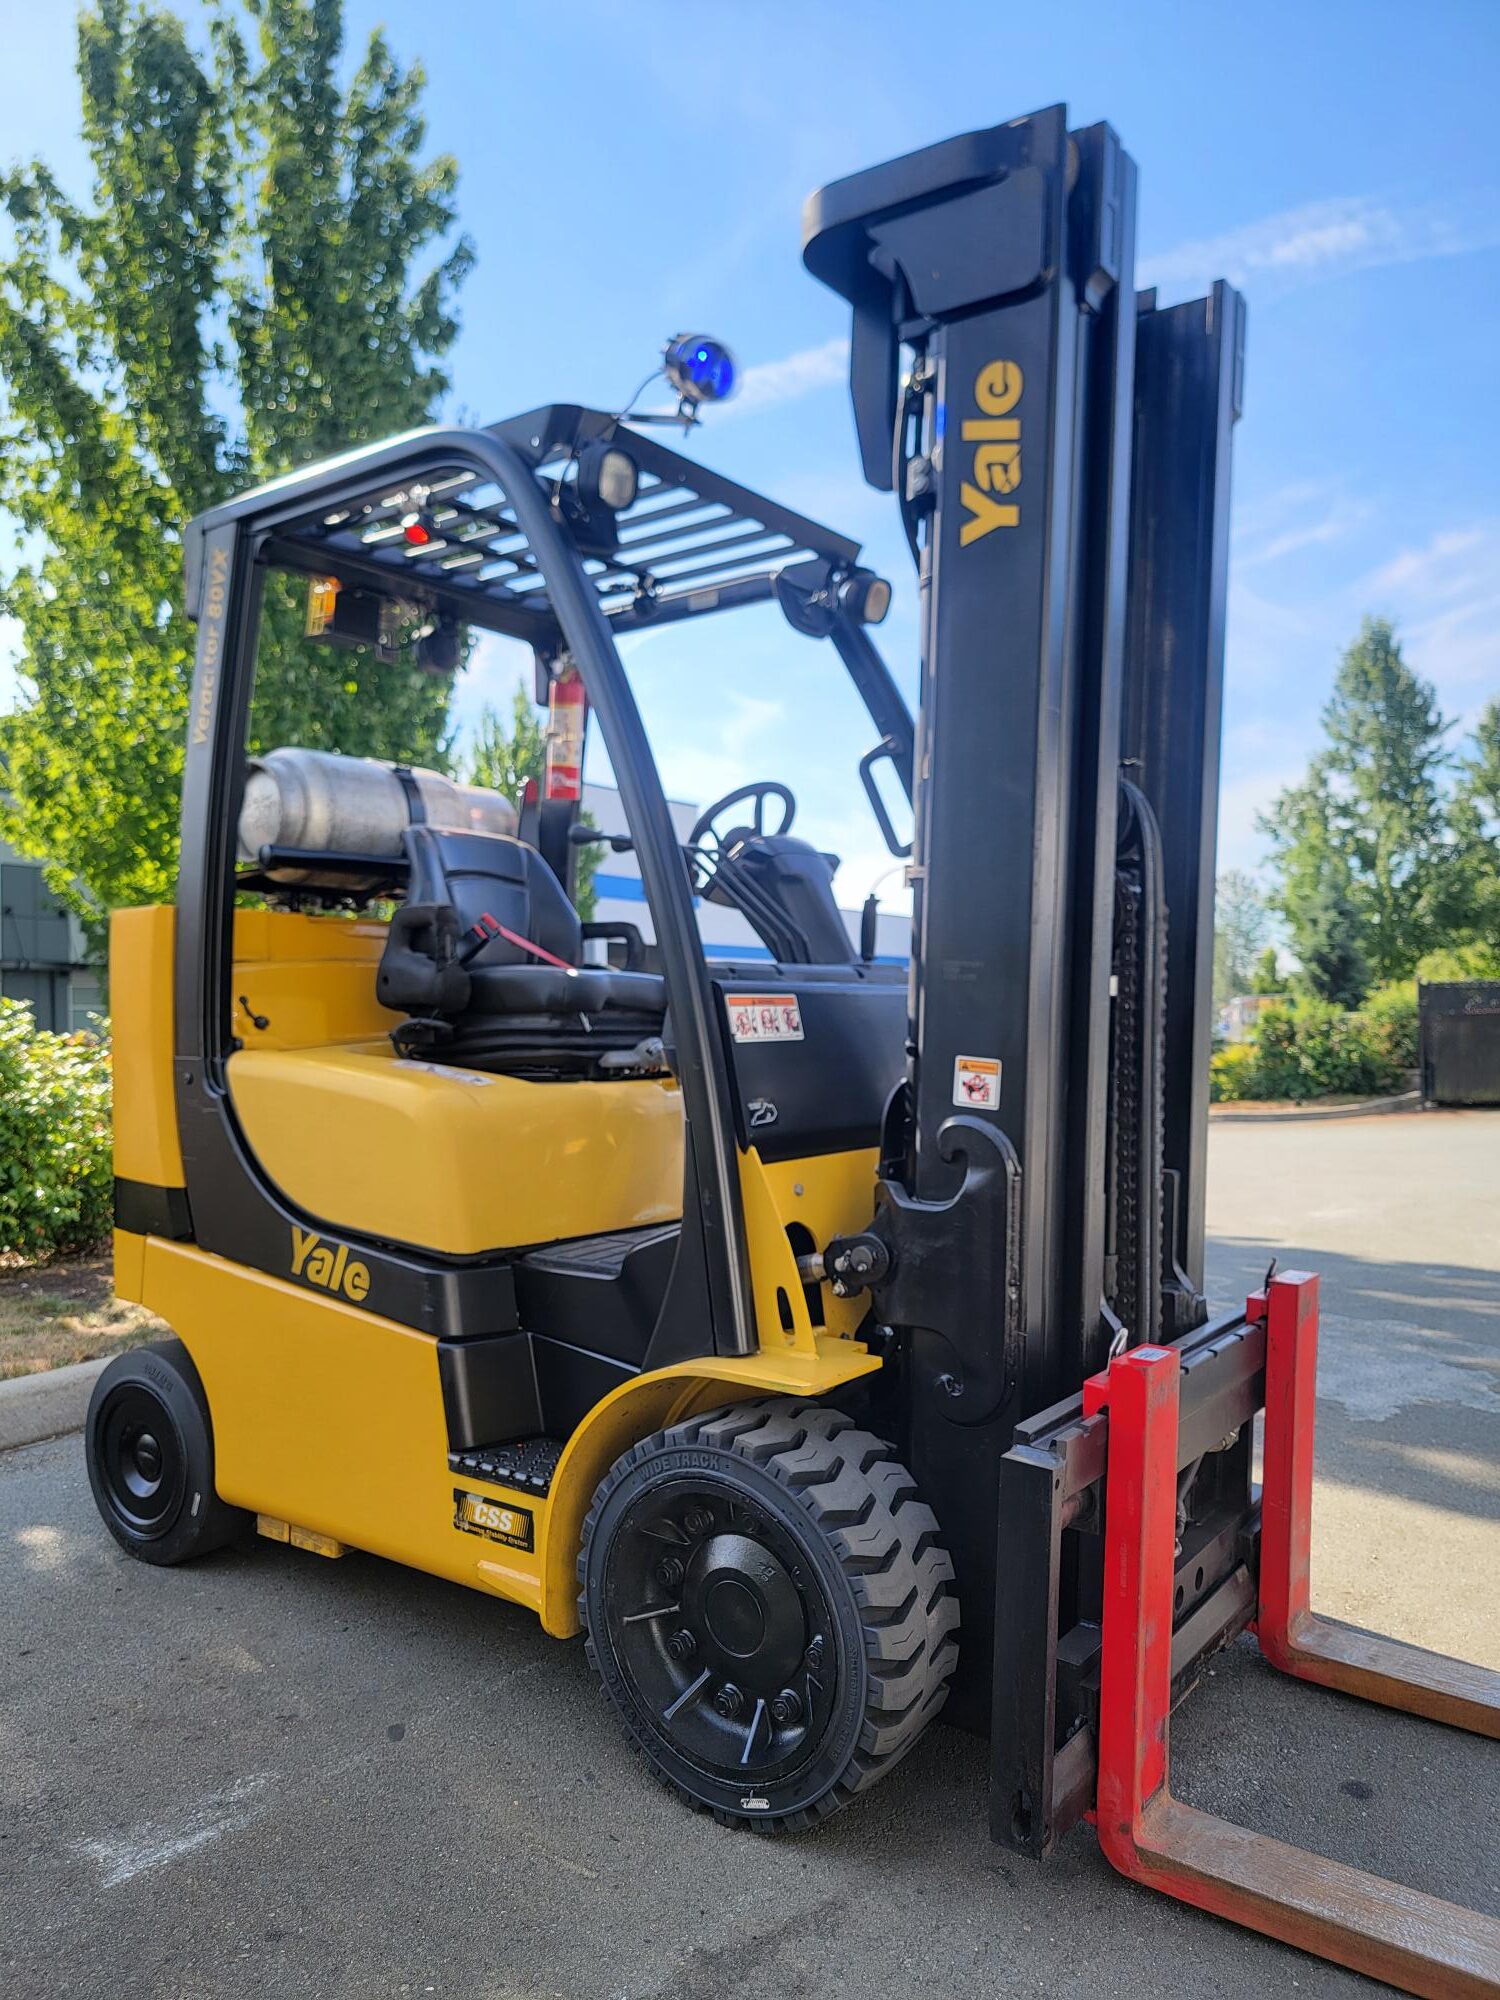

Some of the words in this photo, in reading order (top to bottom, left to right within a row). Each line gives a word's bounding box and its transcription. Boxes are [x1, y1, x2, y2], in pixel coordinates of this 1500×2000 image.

[961, 360, 1024, 548] Yale
[192, 626, 218, 745] Veracitor
[207, 547, 228, 620] 80VX
[290, 1225, 371, 1302] Yale
[637, 1455, 671, 1482] WIDE
[672, 1453, 720, 1470] TRACK
[474, 1503, 513, 1531] CSS
